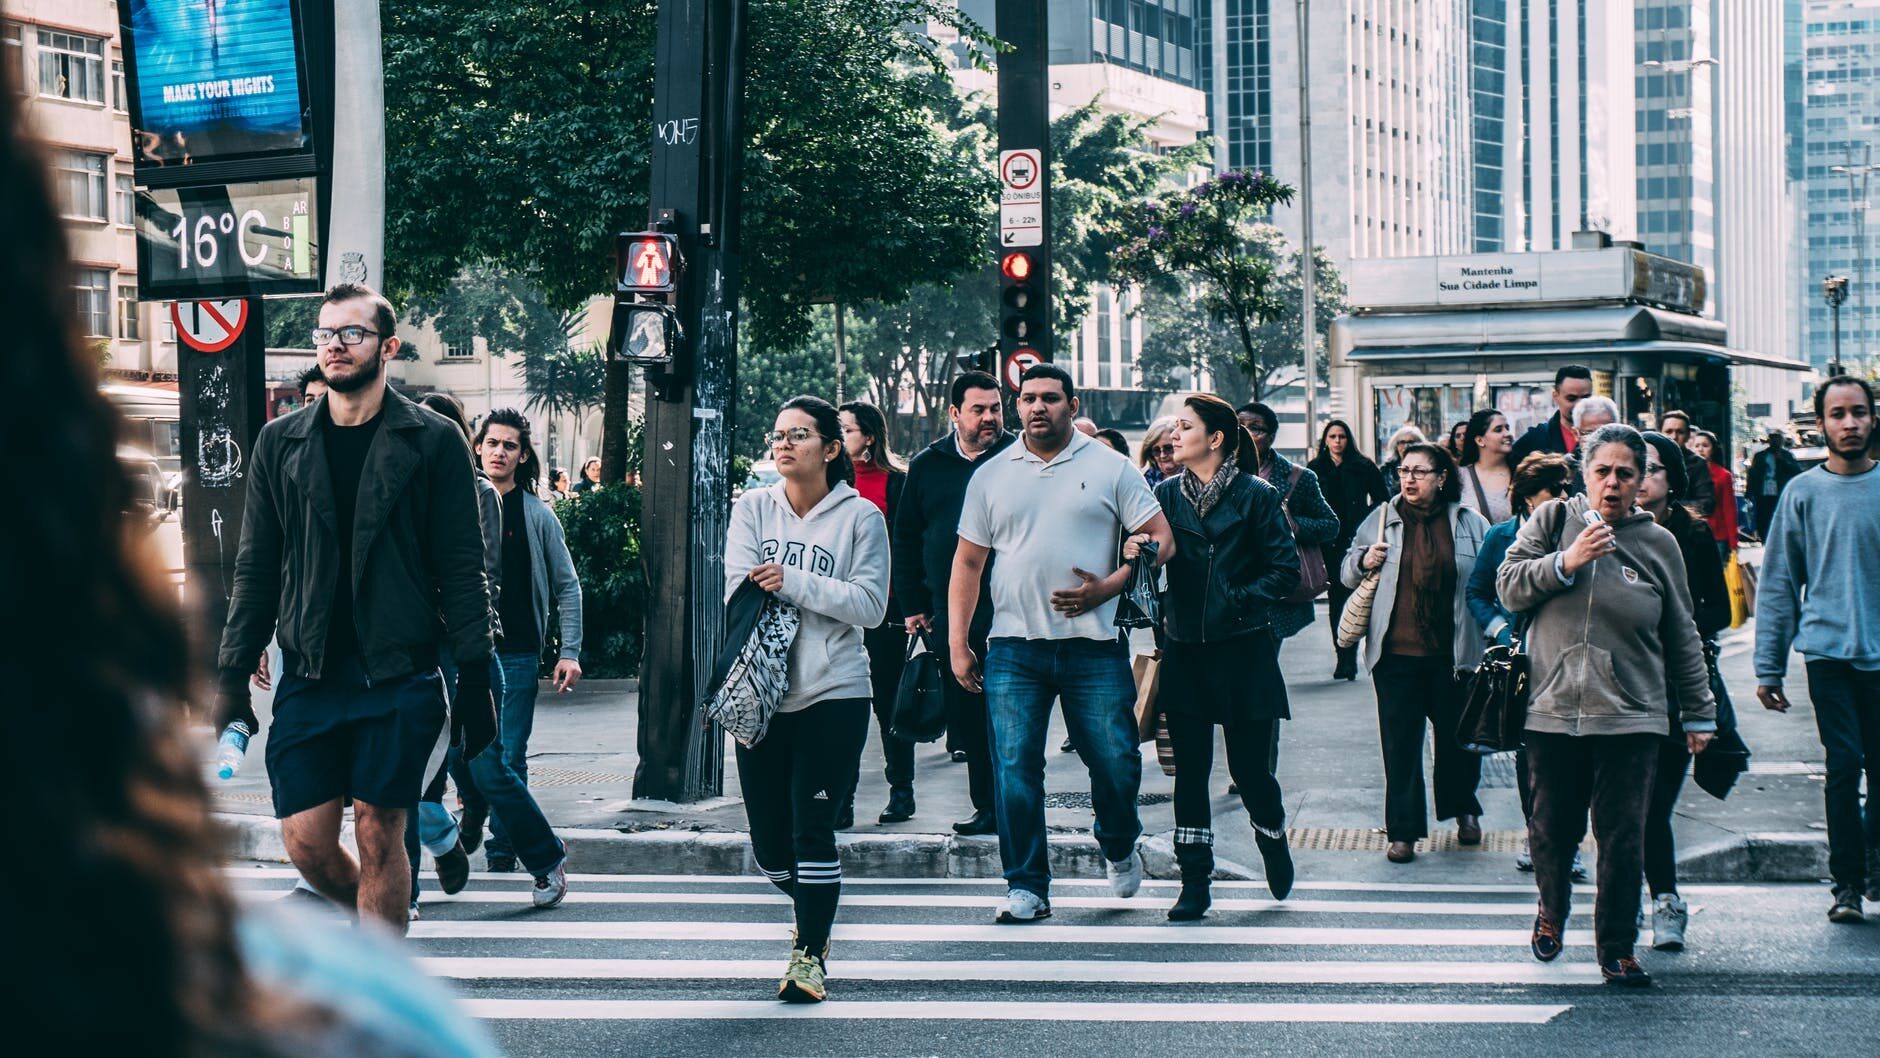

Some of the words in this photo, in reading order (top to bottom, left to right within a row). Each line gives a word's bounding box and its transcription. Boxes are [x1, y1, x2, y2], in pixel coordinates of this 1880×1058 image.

[163, 83, 197, 103] MAKE
[197, 80, 231, 100] YOUR
[231, 75, 275, 96] NIGHTS
[293, 201, 308, 214] AR
[1461, 266, 1514, 277] Mantenha
[1440, 282, 1460, 291] Sua
[1463, 279, 1501, 291] Cidade
[1504, 279, 1538, 289] Limpa
